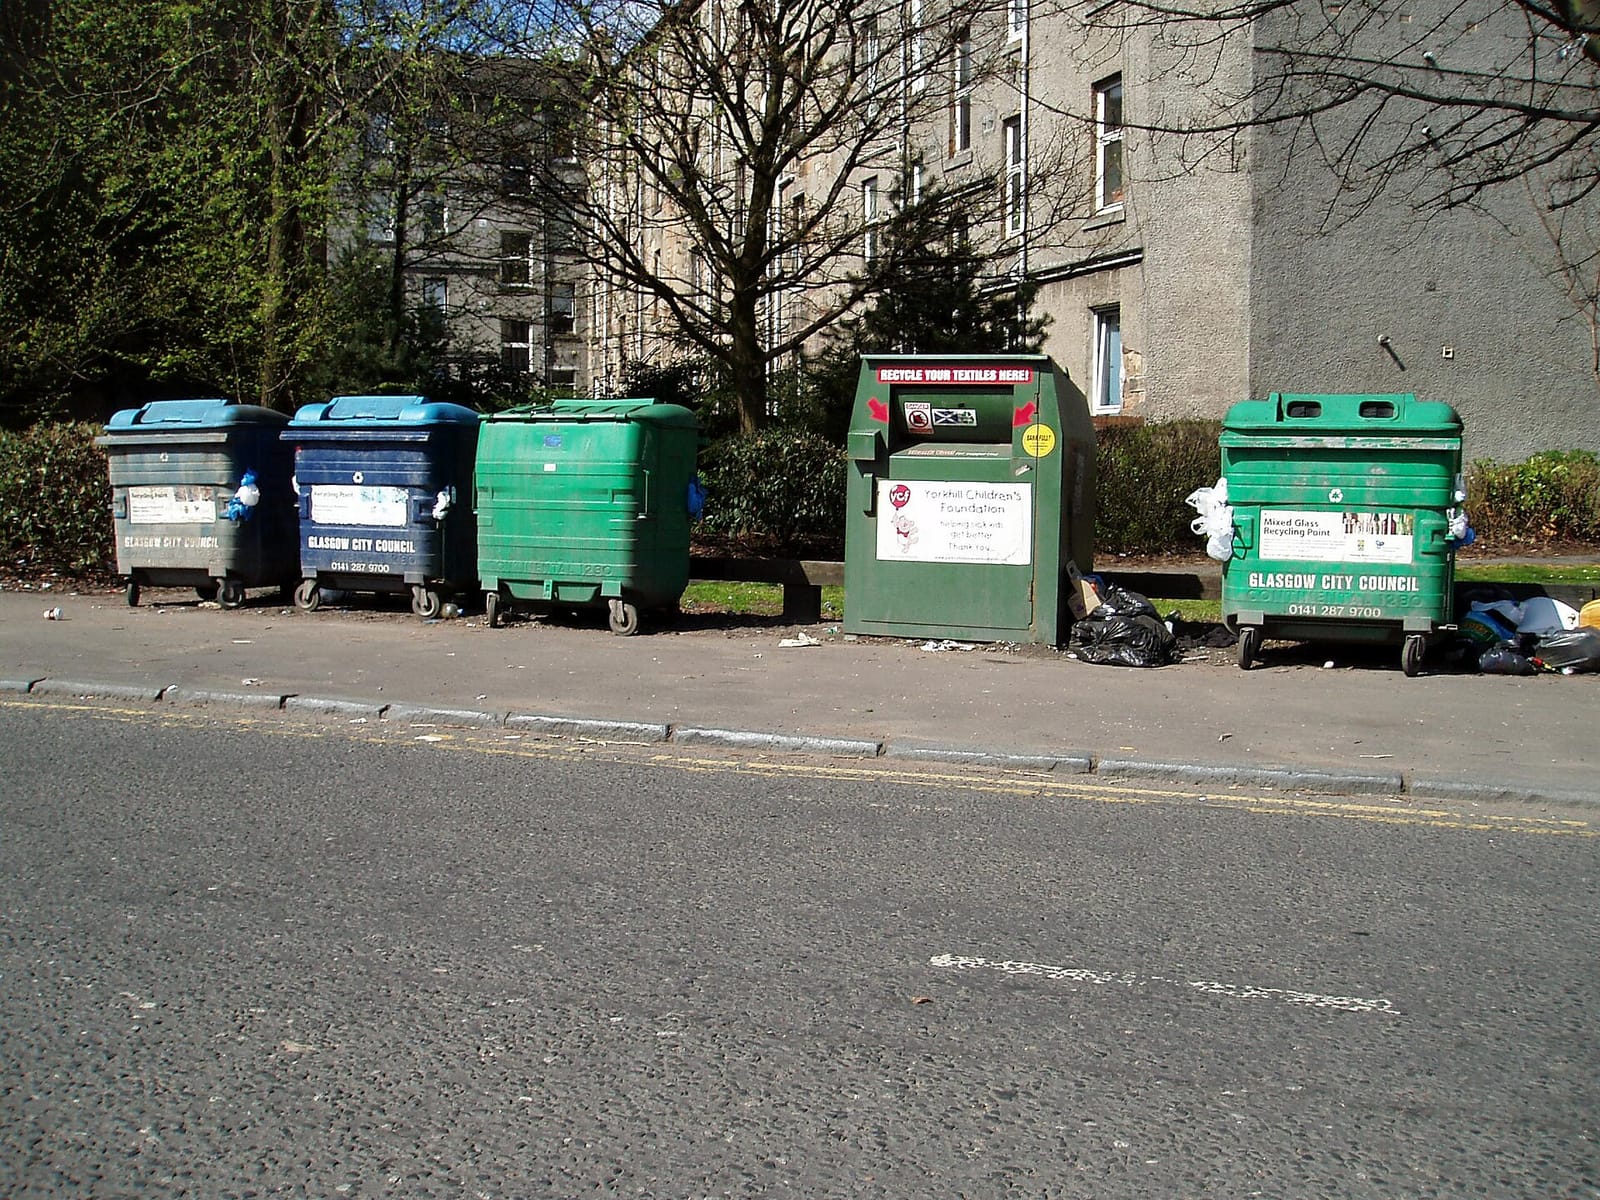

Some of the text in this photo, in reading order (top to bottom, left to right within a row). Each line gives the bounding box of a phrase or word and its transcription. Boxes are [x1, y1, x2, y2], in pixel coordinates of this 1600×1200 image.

[881, 369, 1029, 382] RECYCLE YOUR TEXTILES HERE!
[891, 490, 911, 503] ycf
[925, 490, 1022, 501] Yorkhill Children's
[940, 503, 1005, 513] Foundation
[1264, 518, 1319, 527] Mixed Glass
[1263, 527, 1330, 538] Recycling Point
[124, 536, 219, 548] GLASGOW CITY COUNCIL
[308, 536, 416, 553] GLASGOW CITY COUNCIL
[949, 543, 972, 551] Thank
[331, 562, 390, 573] 0141 287 9700
[1249, 573, 1419, 592] GLASGOW CITY COUNCIL
[1289, 604, 1381, 618] 0141 287 9700
